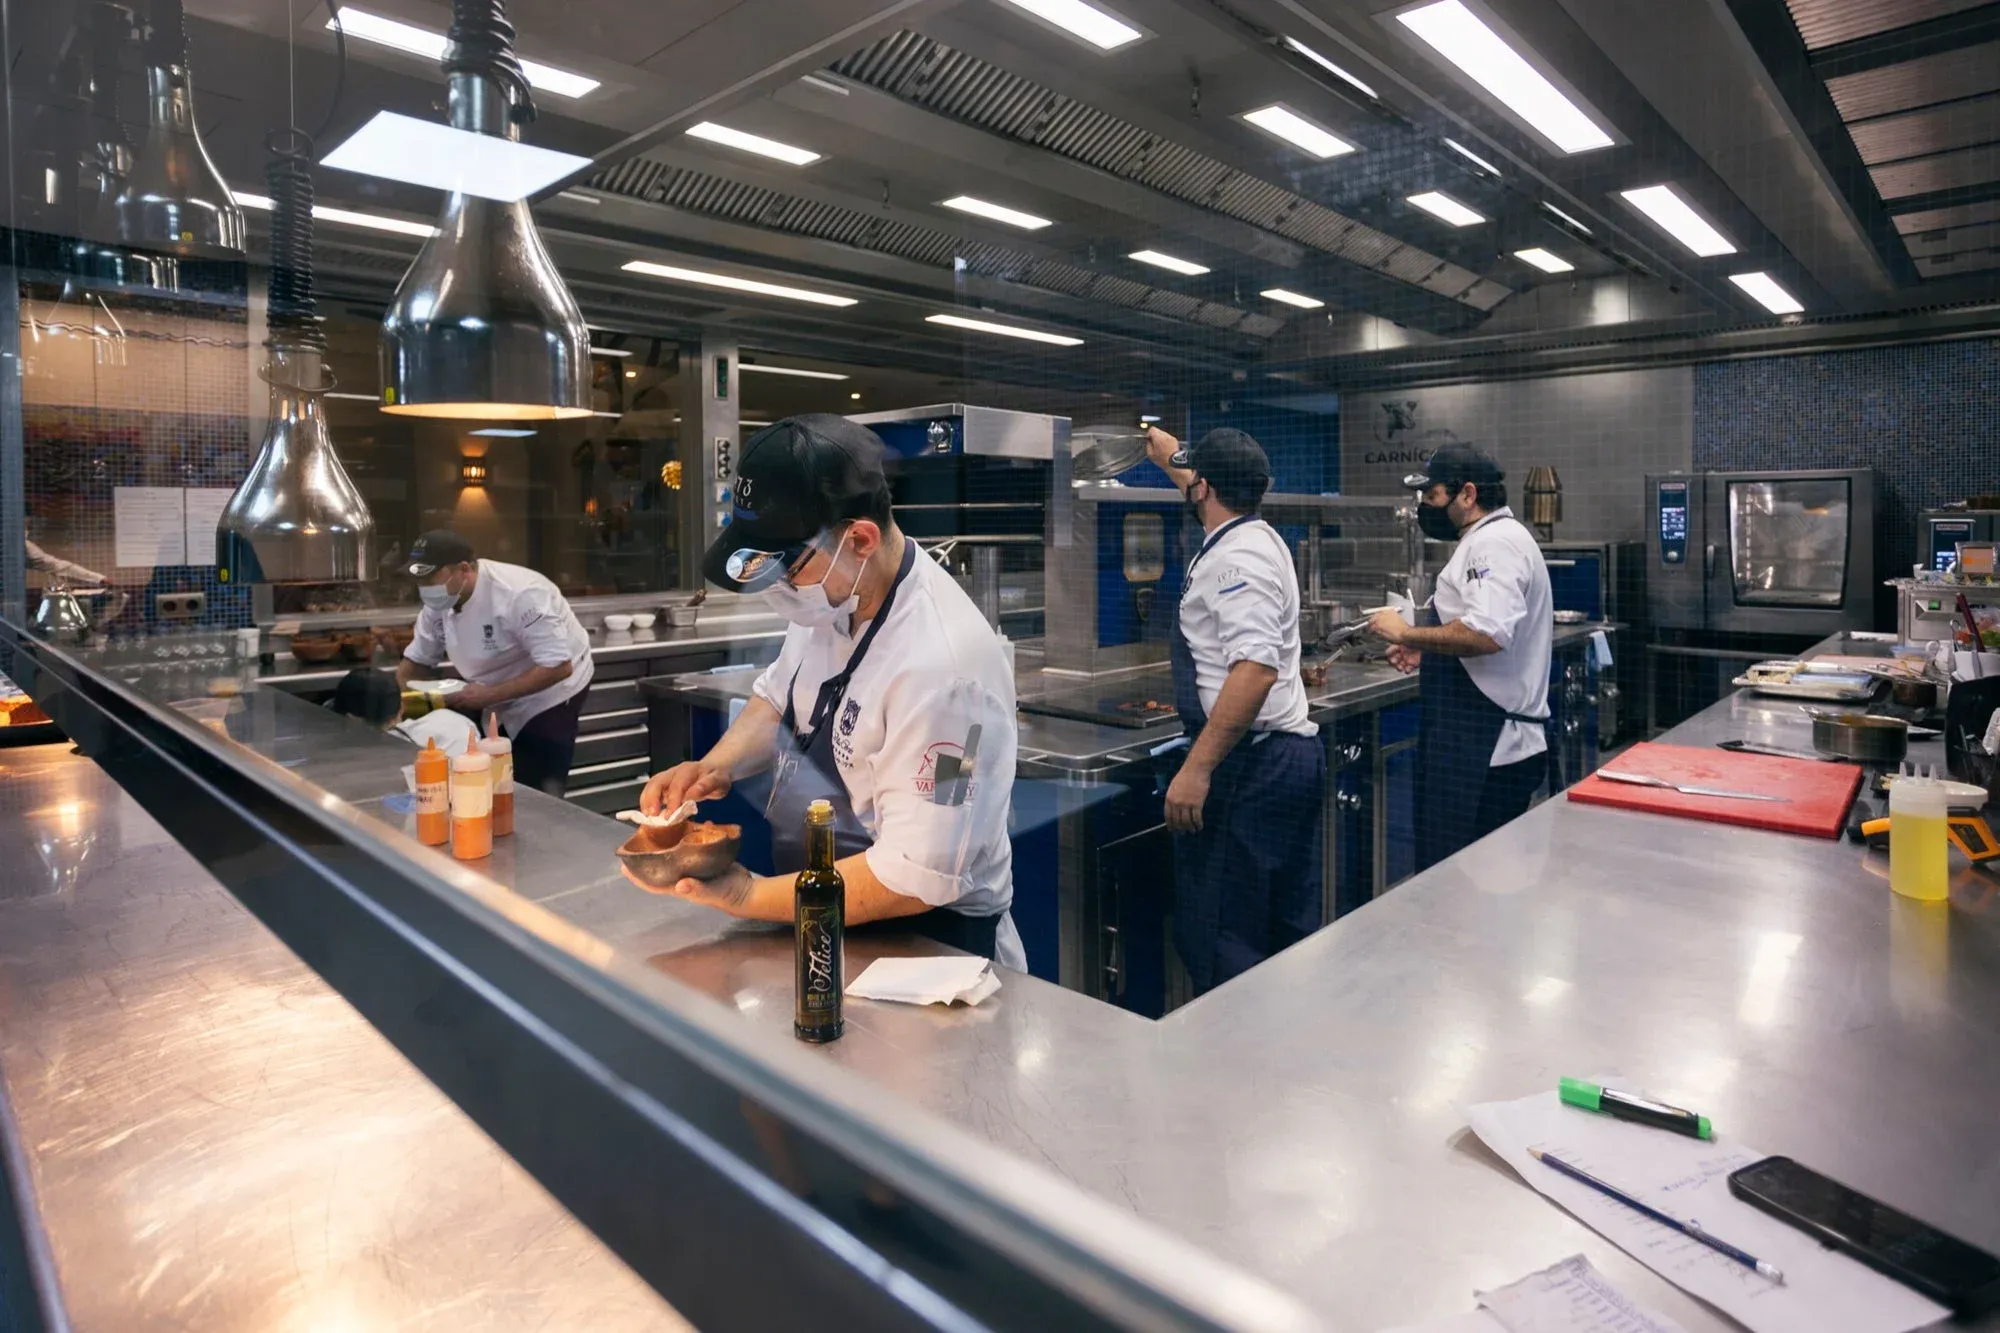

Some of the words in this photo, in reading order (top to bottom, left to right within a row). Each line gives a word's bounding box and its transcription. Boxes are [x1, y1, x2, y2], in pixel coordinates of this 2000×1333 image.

[1365, 446, 1434, 464] CARNÍC
[734, 476, 753, 497] 73
[809, 921, 832, 993] Felice
